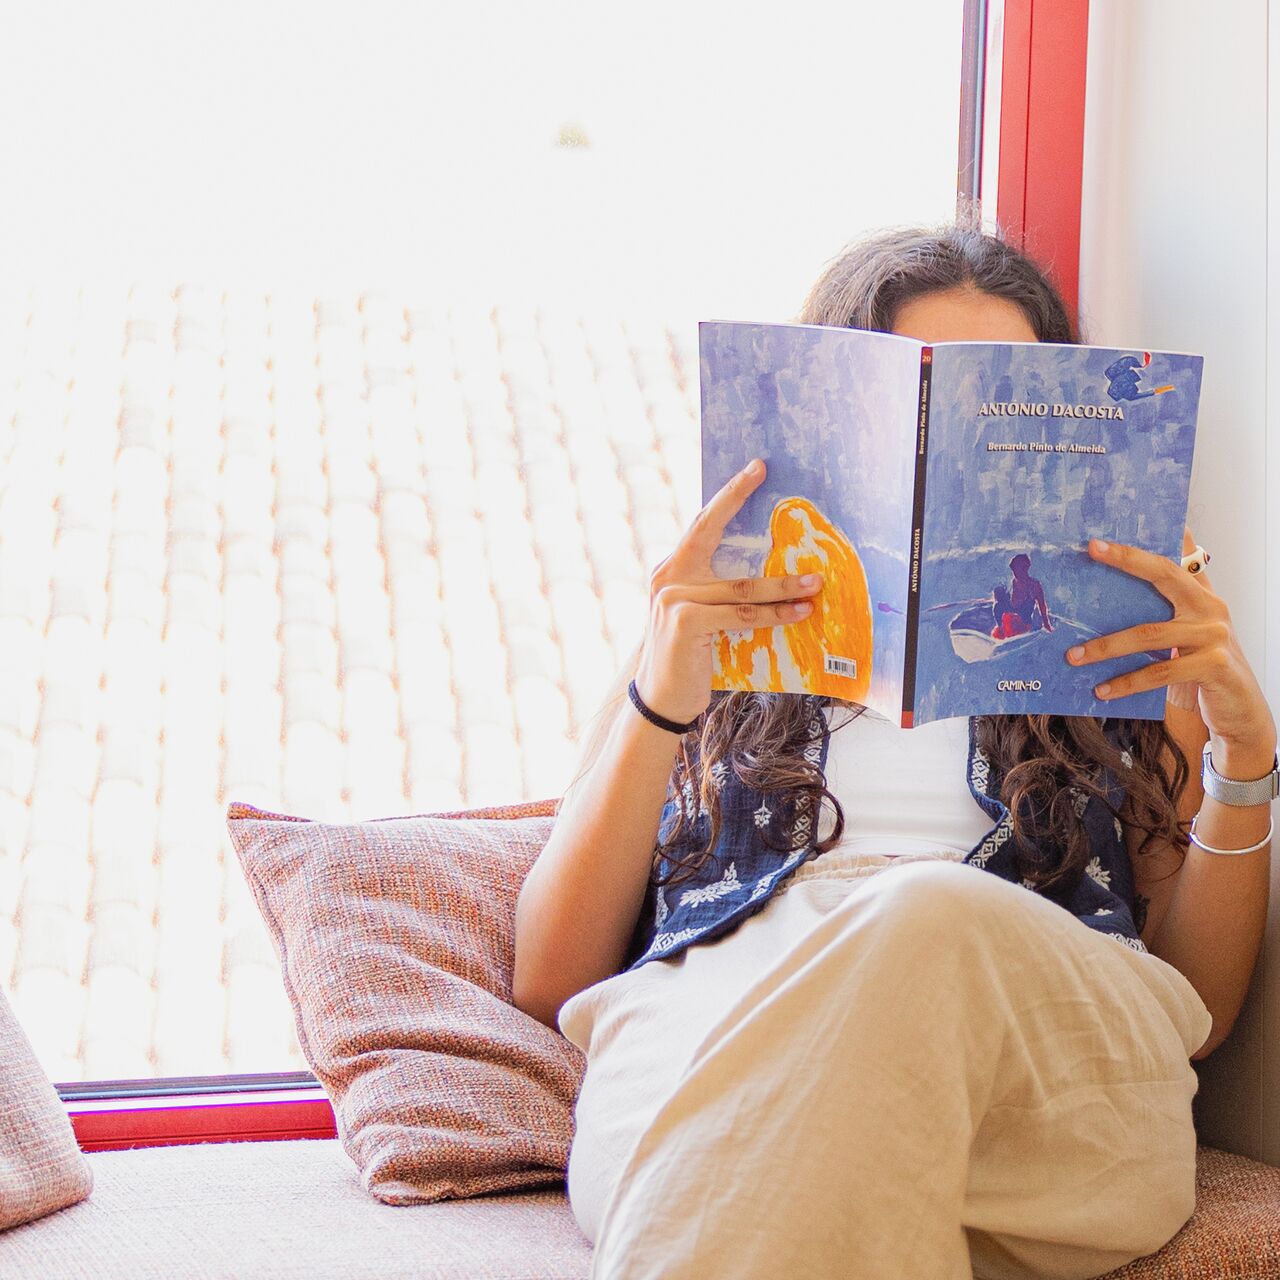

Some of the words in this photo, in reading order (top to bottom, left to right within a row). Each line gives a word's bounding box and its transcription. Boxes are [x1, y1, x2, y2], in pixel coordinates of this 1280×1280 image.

[978, 400, 1049, 417] ANTÓNIO
[1052, 403, 1124, 420] DACOSTA
[987, 442, 1027, 452] Bernardo
[1028, 442, 1052, 452] Pinto
[1055, 443, 1066, 452] de
[1068, 444, 1106, 454] Almeida
[997, 680, 1041, 692] CAMINHO
